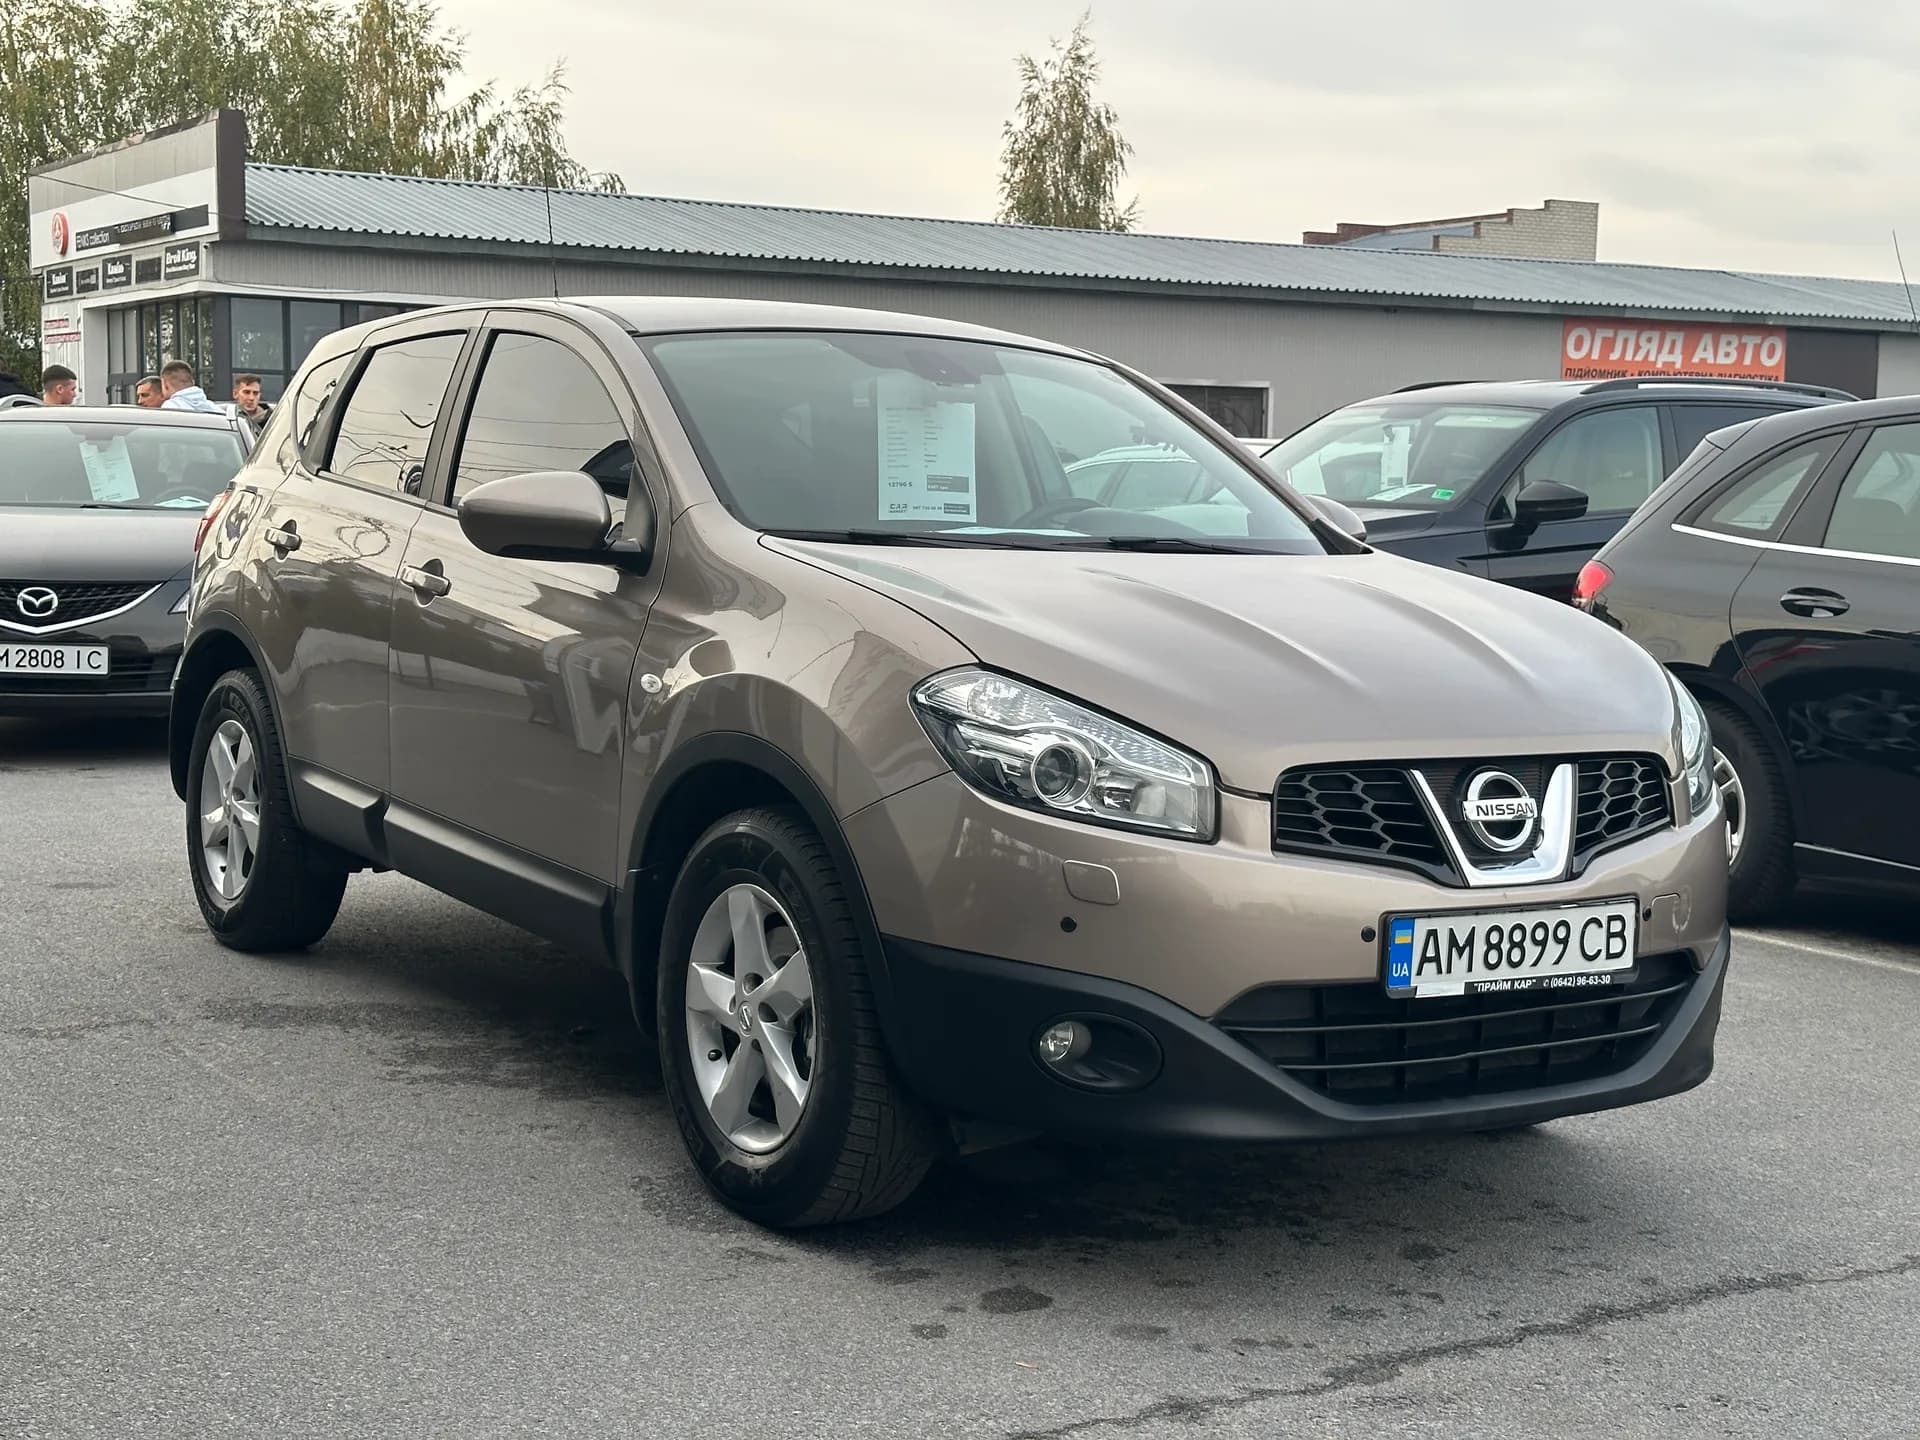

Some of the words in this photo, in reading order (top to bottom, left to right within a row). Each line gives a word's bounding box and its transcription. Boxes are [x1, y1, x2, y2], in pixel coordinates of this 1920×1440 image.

[1566, 327, 1685, 368] ОГЛЯД
[1691, 332, 1783, 367] АВТО
[1564, 367, 1628, 379] ПІДЙОМНИК
[15, 648, 65, 669] 2808
[76, 649, 102, 669] IC
[1475, 802, 1535, 817] NISSAN
[1416, 926, 1476, 976] AM
[1483, 919, 1571, 971] 8899
[1579, 914, 1628, 962] CB
[1392, 962, 1409, 977] UA
